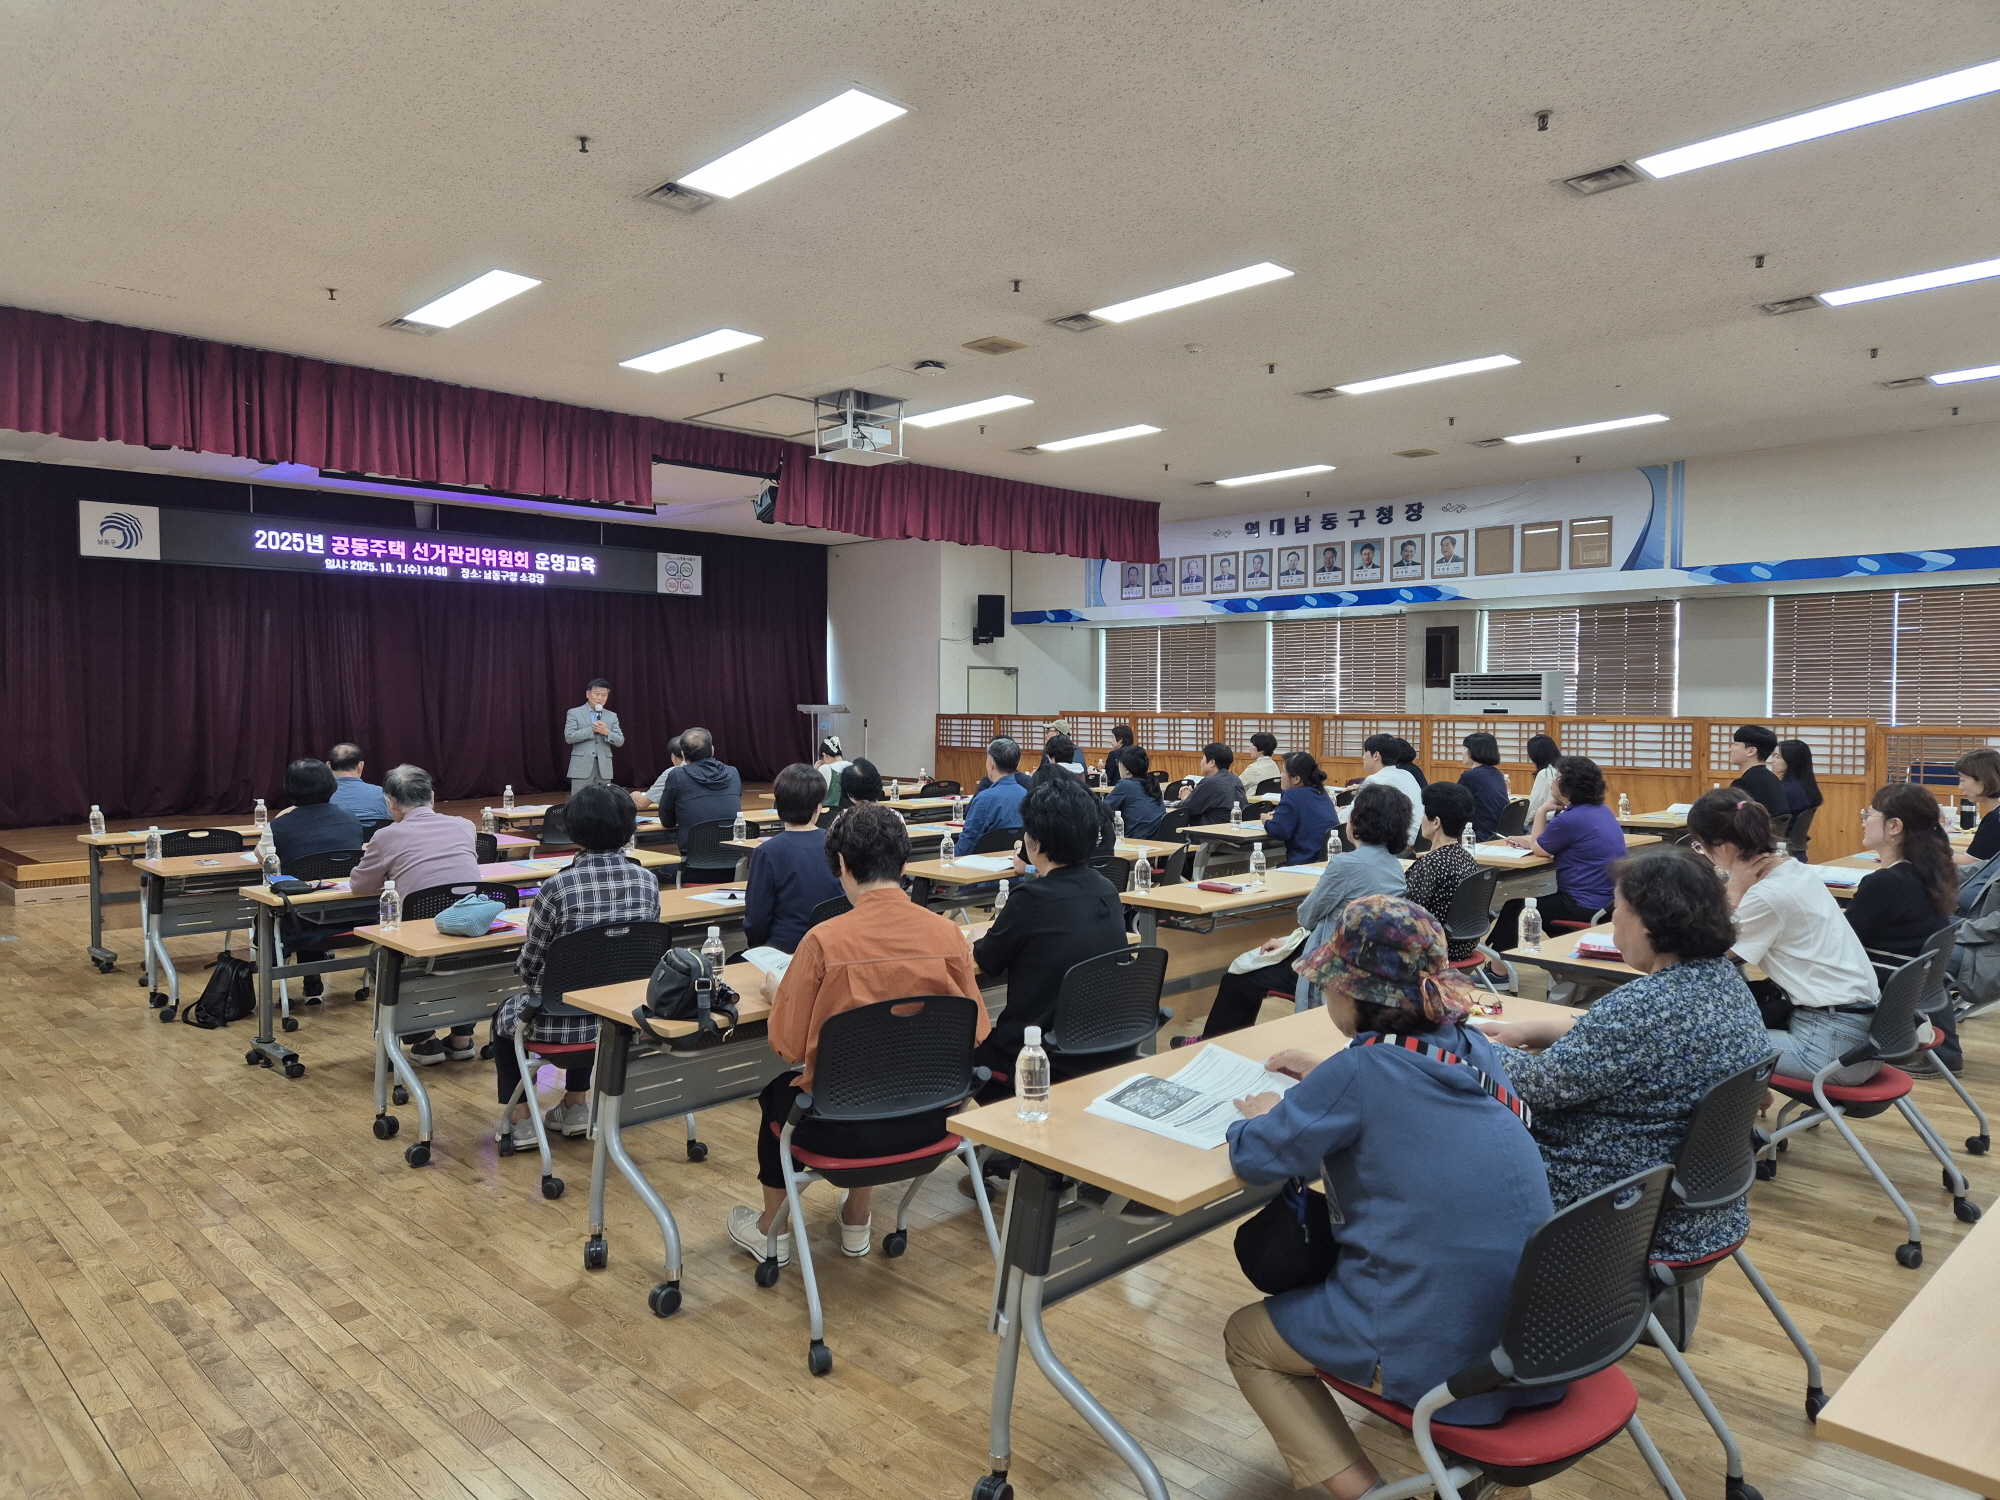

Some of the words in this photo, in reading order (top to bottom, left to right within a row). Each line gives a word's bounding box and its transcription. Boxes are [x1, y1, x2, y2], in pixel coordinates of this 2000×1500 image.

[254, 529, 325, 555] 2025년
[331, 535, 406, 560] 공동주택
[412, 542, 529, 569] 선거관리위원회
[535, 552, 597, 575] 운영교육
[350, 560, 379, 572] 2025.
[380, 562, 395, 573] 10.
[423, 565, 448, 577] 14:00
[461, 567, 482, 579] 장소:
[484, 570, 518, 582] 남동구청
